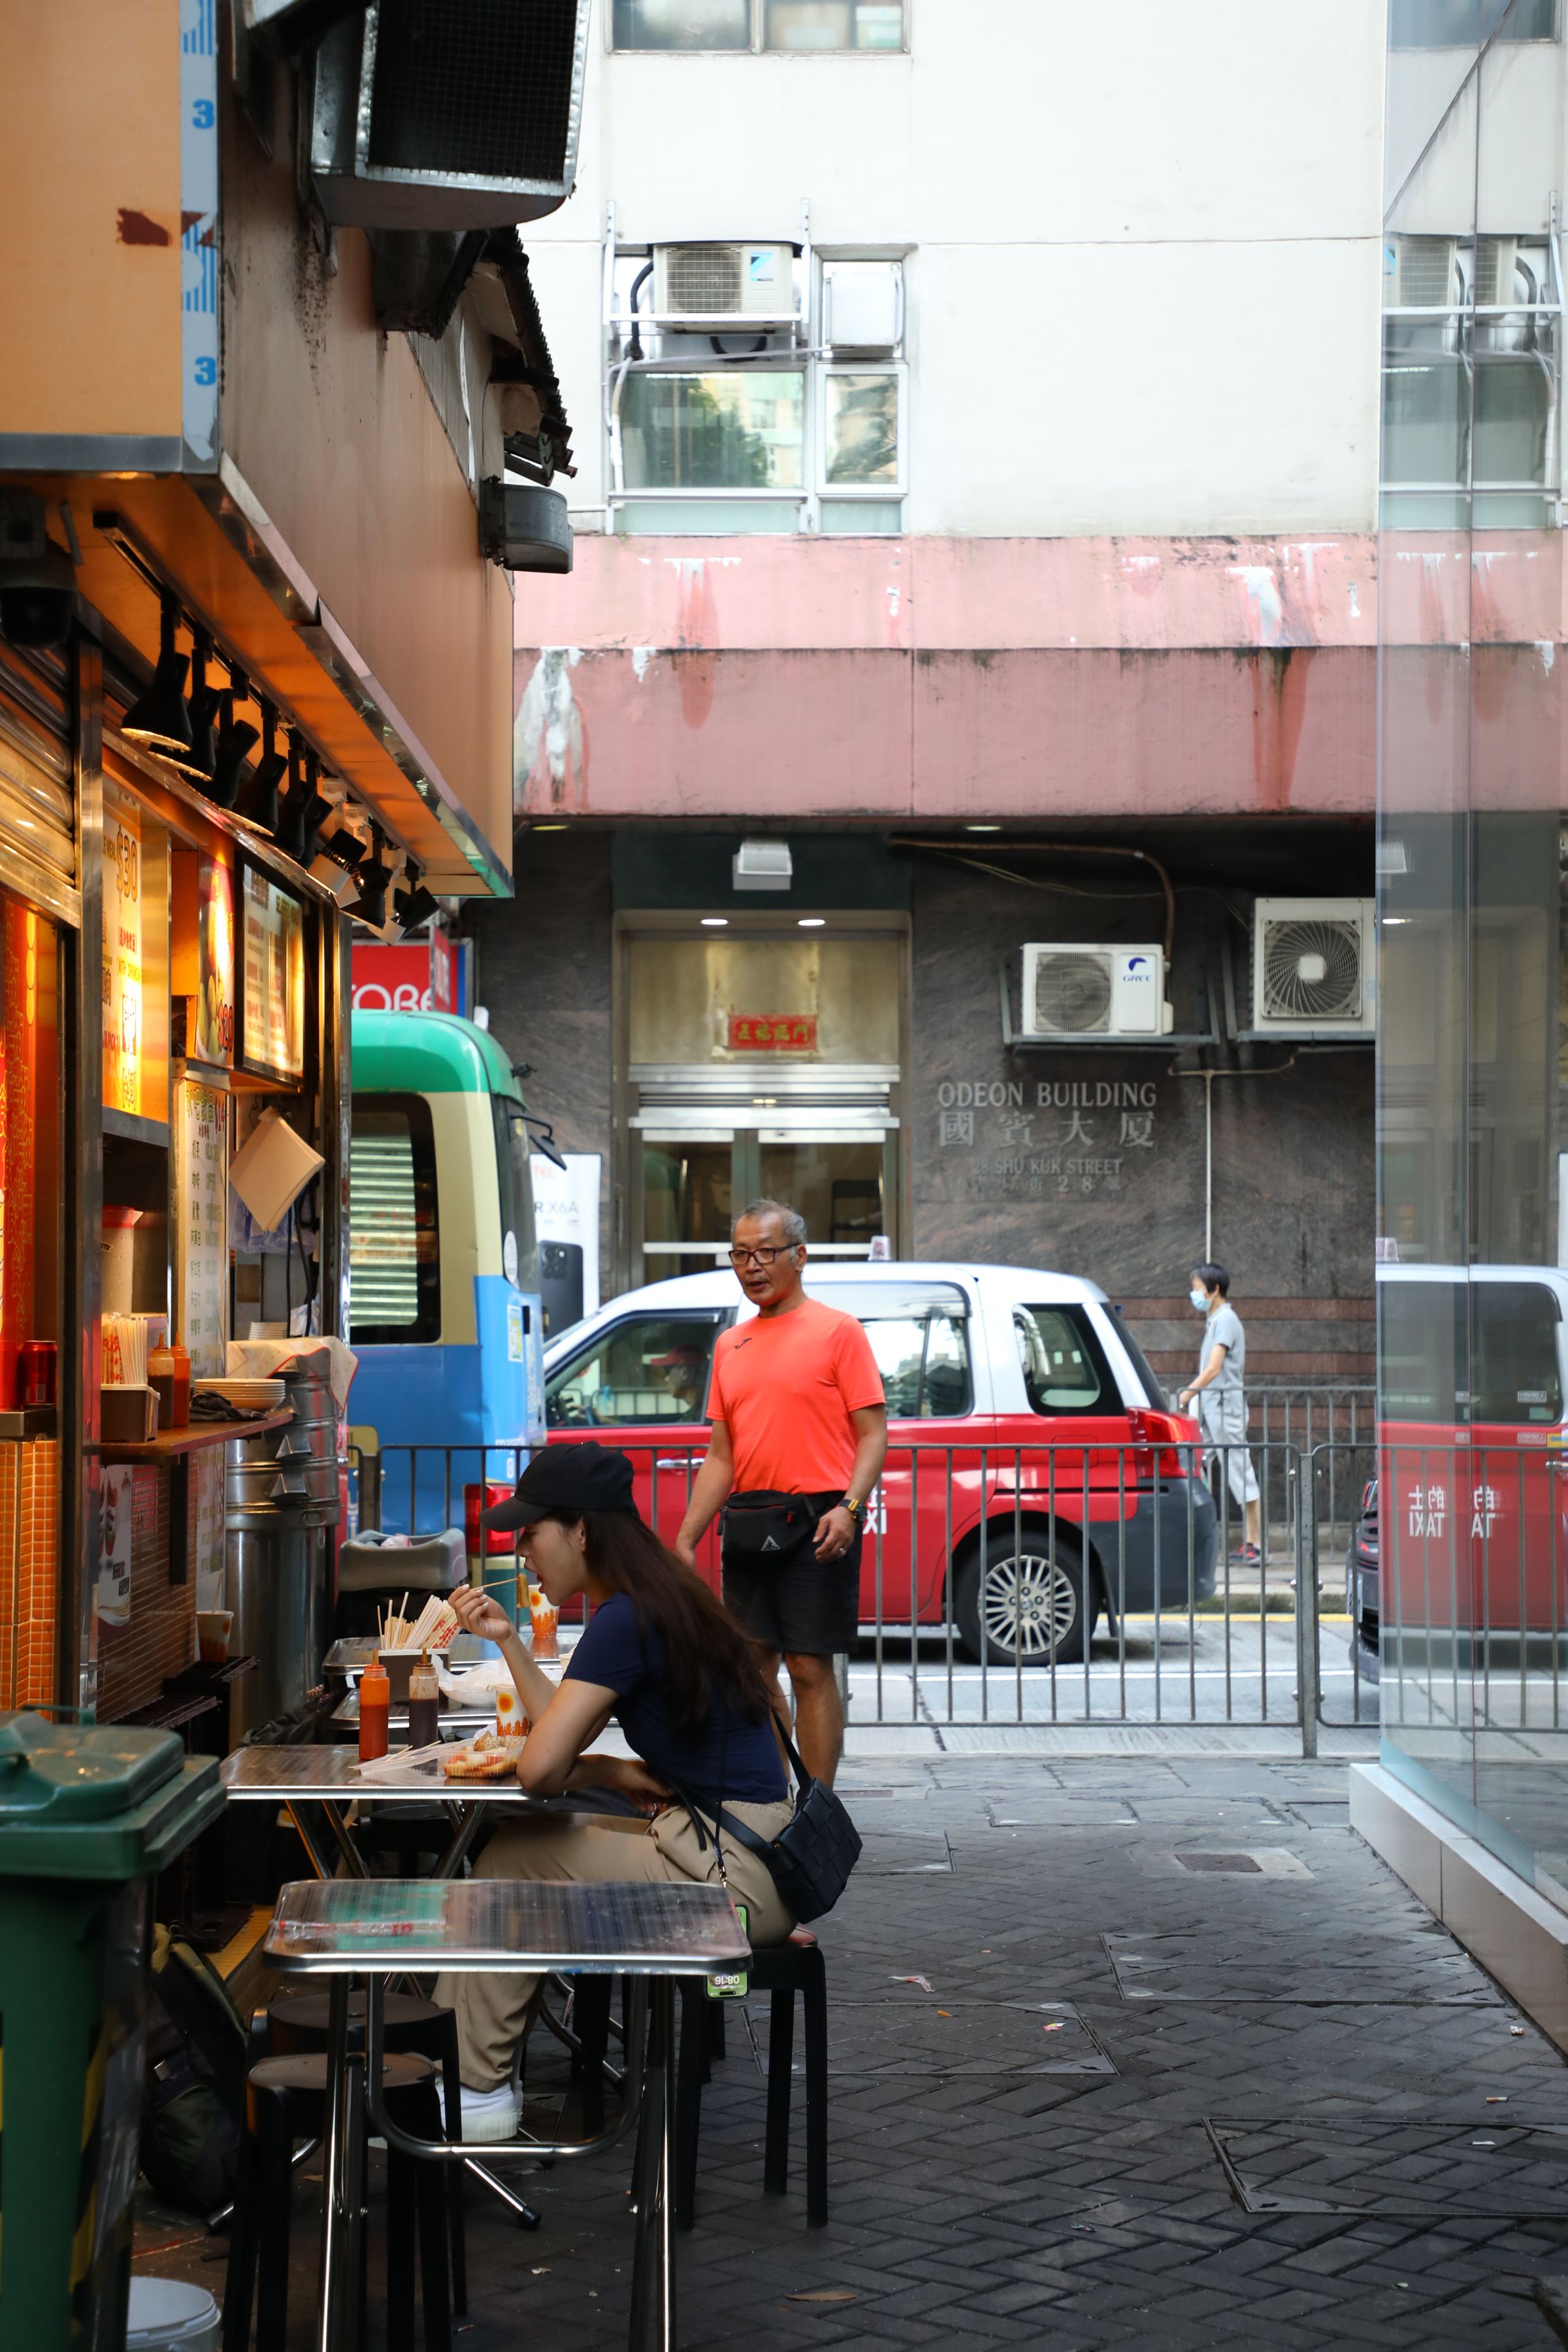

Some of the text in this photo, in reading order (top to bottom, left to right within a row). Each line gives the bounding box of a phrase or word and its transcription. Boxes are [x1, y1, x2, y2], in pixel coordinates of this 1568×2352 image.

[192, 99, 214, 128] 3
[194, 357, 216, 385] 3
[116, 824, 138, 903] $30
[218, 999, 234, 1053] $20
[938, 1082, 1157, 1107] ODEON BUILDING
[994, 1158, 1024, 1175] SHU
[1030, 1158, 1061, 1175] KUK
[1066, 1158, 1123, 1175] STREET
[715, 1975, 740, 1984] 08:16
